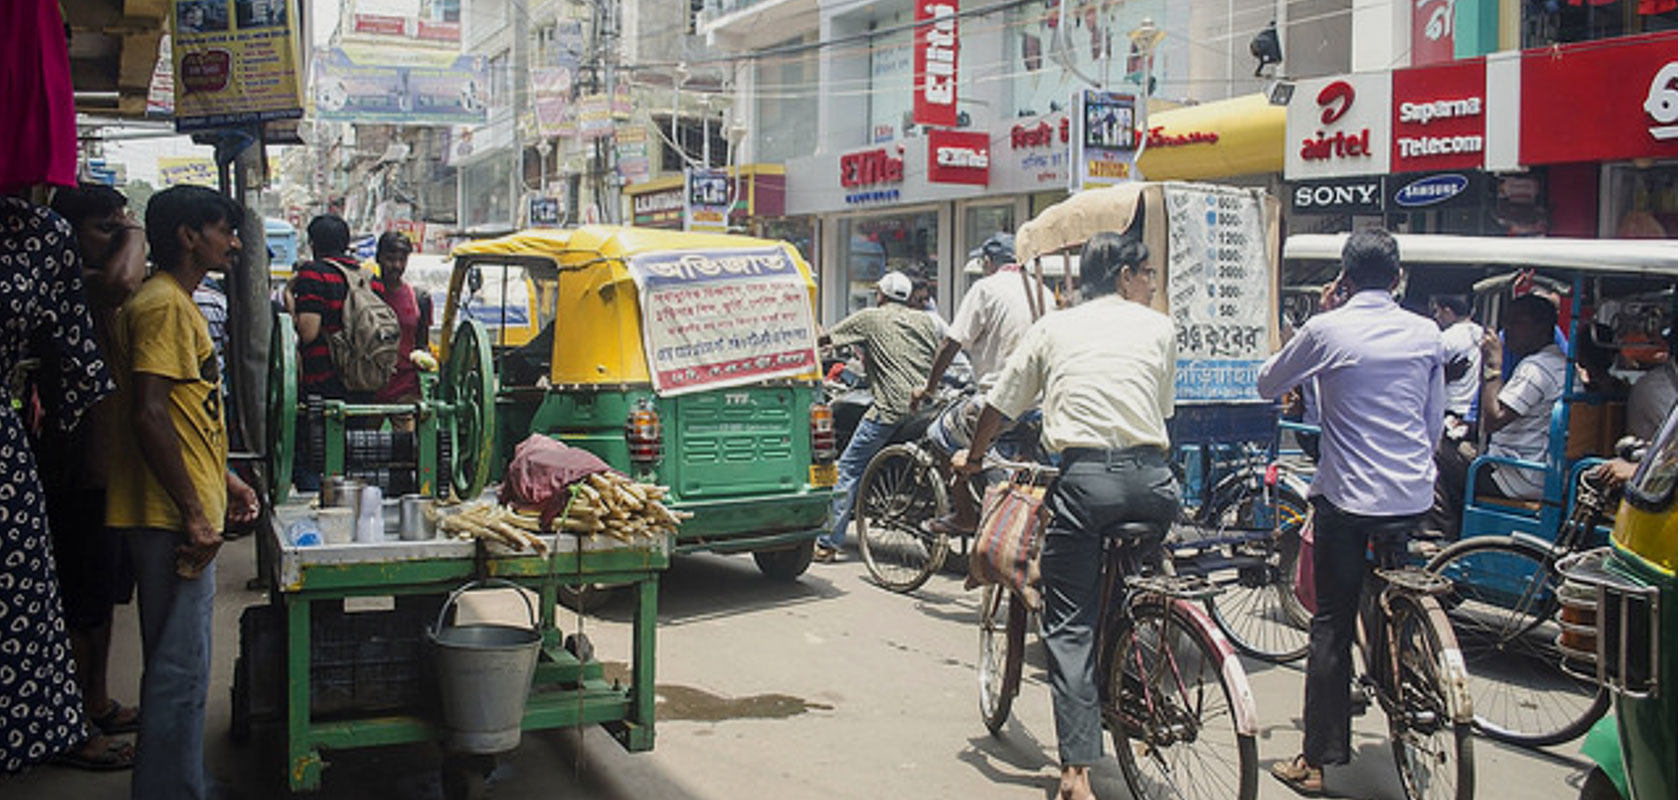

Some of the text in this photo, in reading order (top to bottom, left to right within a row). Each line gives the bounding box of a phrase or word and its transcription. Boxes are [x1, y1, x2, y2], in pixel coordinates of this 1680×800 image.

[1399, 97, 1481, 124] Suparna
[1300, 129, 1372, 161] airtel
[1398, 136, 1482, 157] Telecom
[1295, 184, 1377, 207] SONY
[1404, 182, 1459, 199] SAMSUNG
[647, 254, 786, 280] অভিজাত
